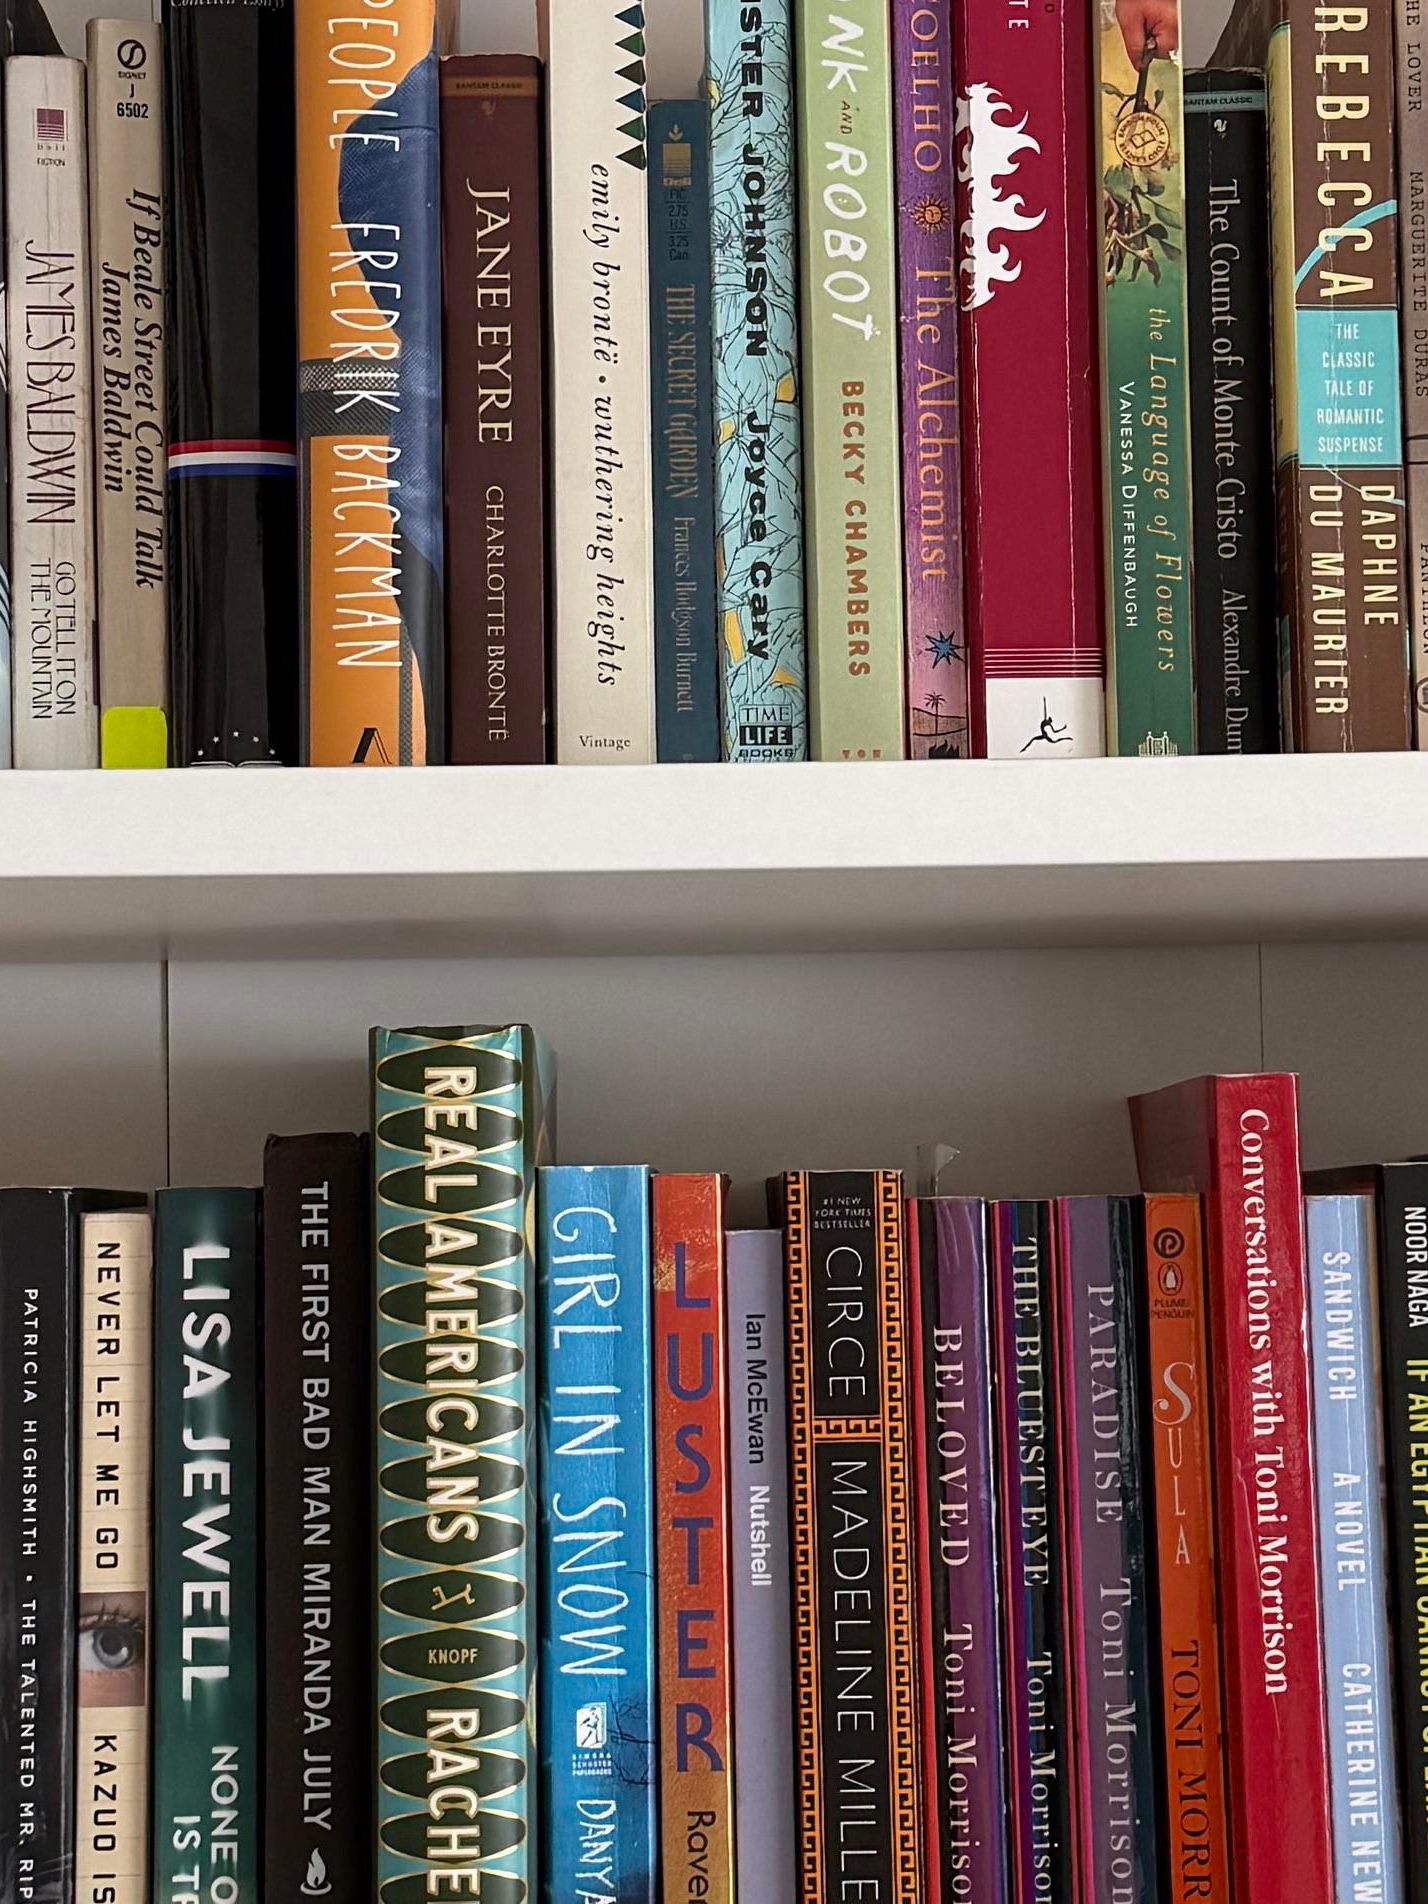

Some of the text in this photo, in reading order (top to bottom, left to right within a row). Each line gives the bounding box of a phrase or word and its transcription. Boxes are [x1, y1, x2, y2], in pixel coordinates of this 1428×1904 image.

[117, 102, 148, 118] 6502
[1313, 7, 1373, 299] REBECCA
[467, 180, 512, 442] JANE EYRE
[1336, 323, 1358, 339] THE
[1323, 352, 1374, 369] CLASSIC
[1325, 380, 1373, 396] TALE OF
[583, 163, 625, 686] emily brontë wuthering heights
[1317, 408, 1383, 424] ROMANTIC
[1318, 436, 1382, 453] SUSPENSE
[842, 382, 870, 676] BECKY CHAMBERS
[743, 707, 789, 721] TIME
[580, 736, 629, 750] Vintage
[745, 727, 787, 744] LIFE
[826, 1247, 865, 1396] CIRCE
[182, 1244, 230, 1701] LISA JEWELL
[671, 1245, 724, 1775] LUSTER
[832, 1462, 874, 1731] MADELINE
[429, 1649, 477, 1663] KNOPF
